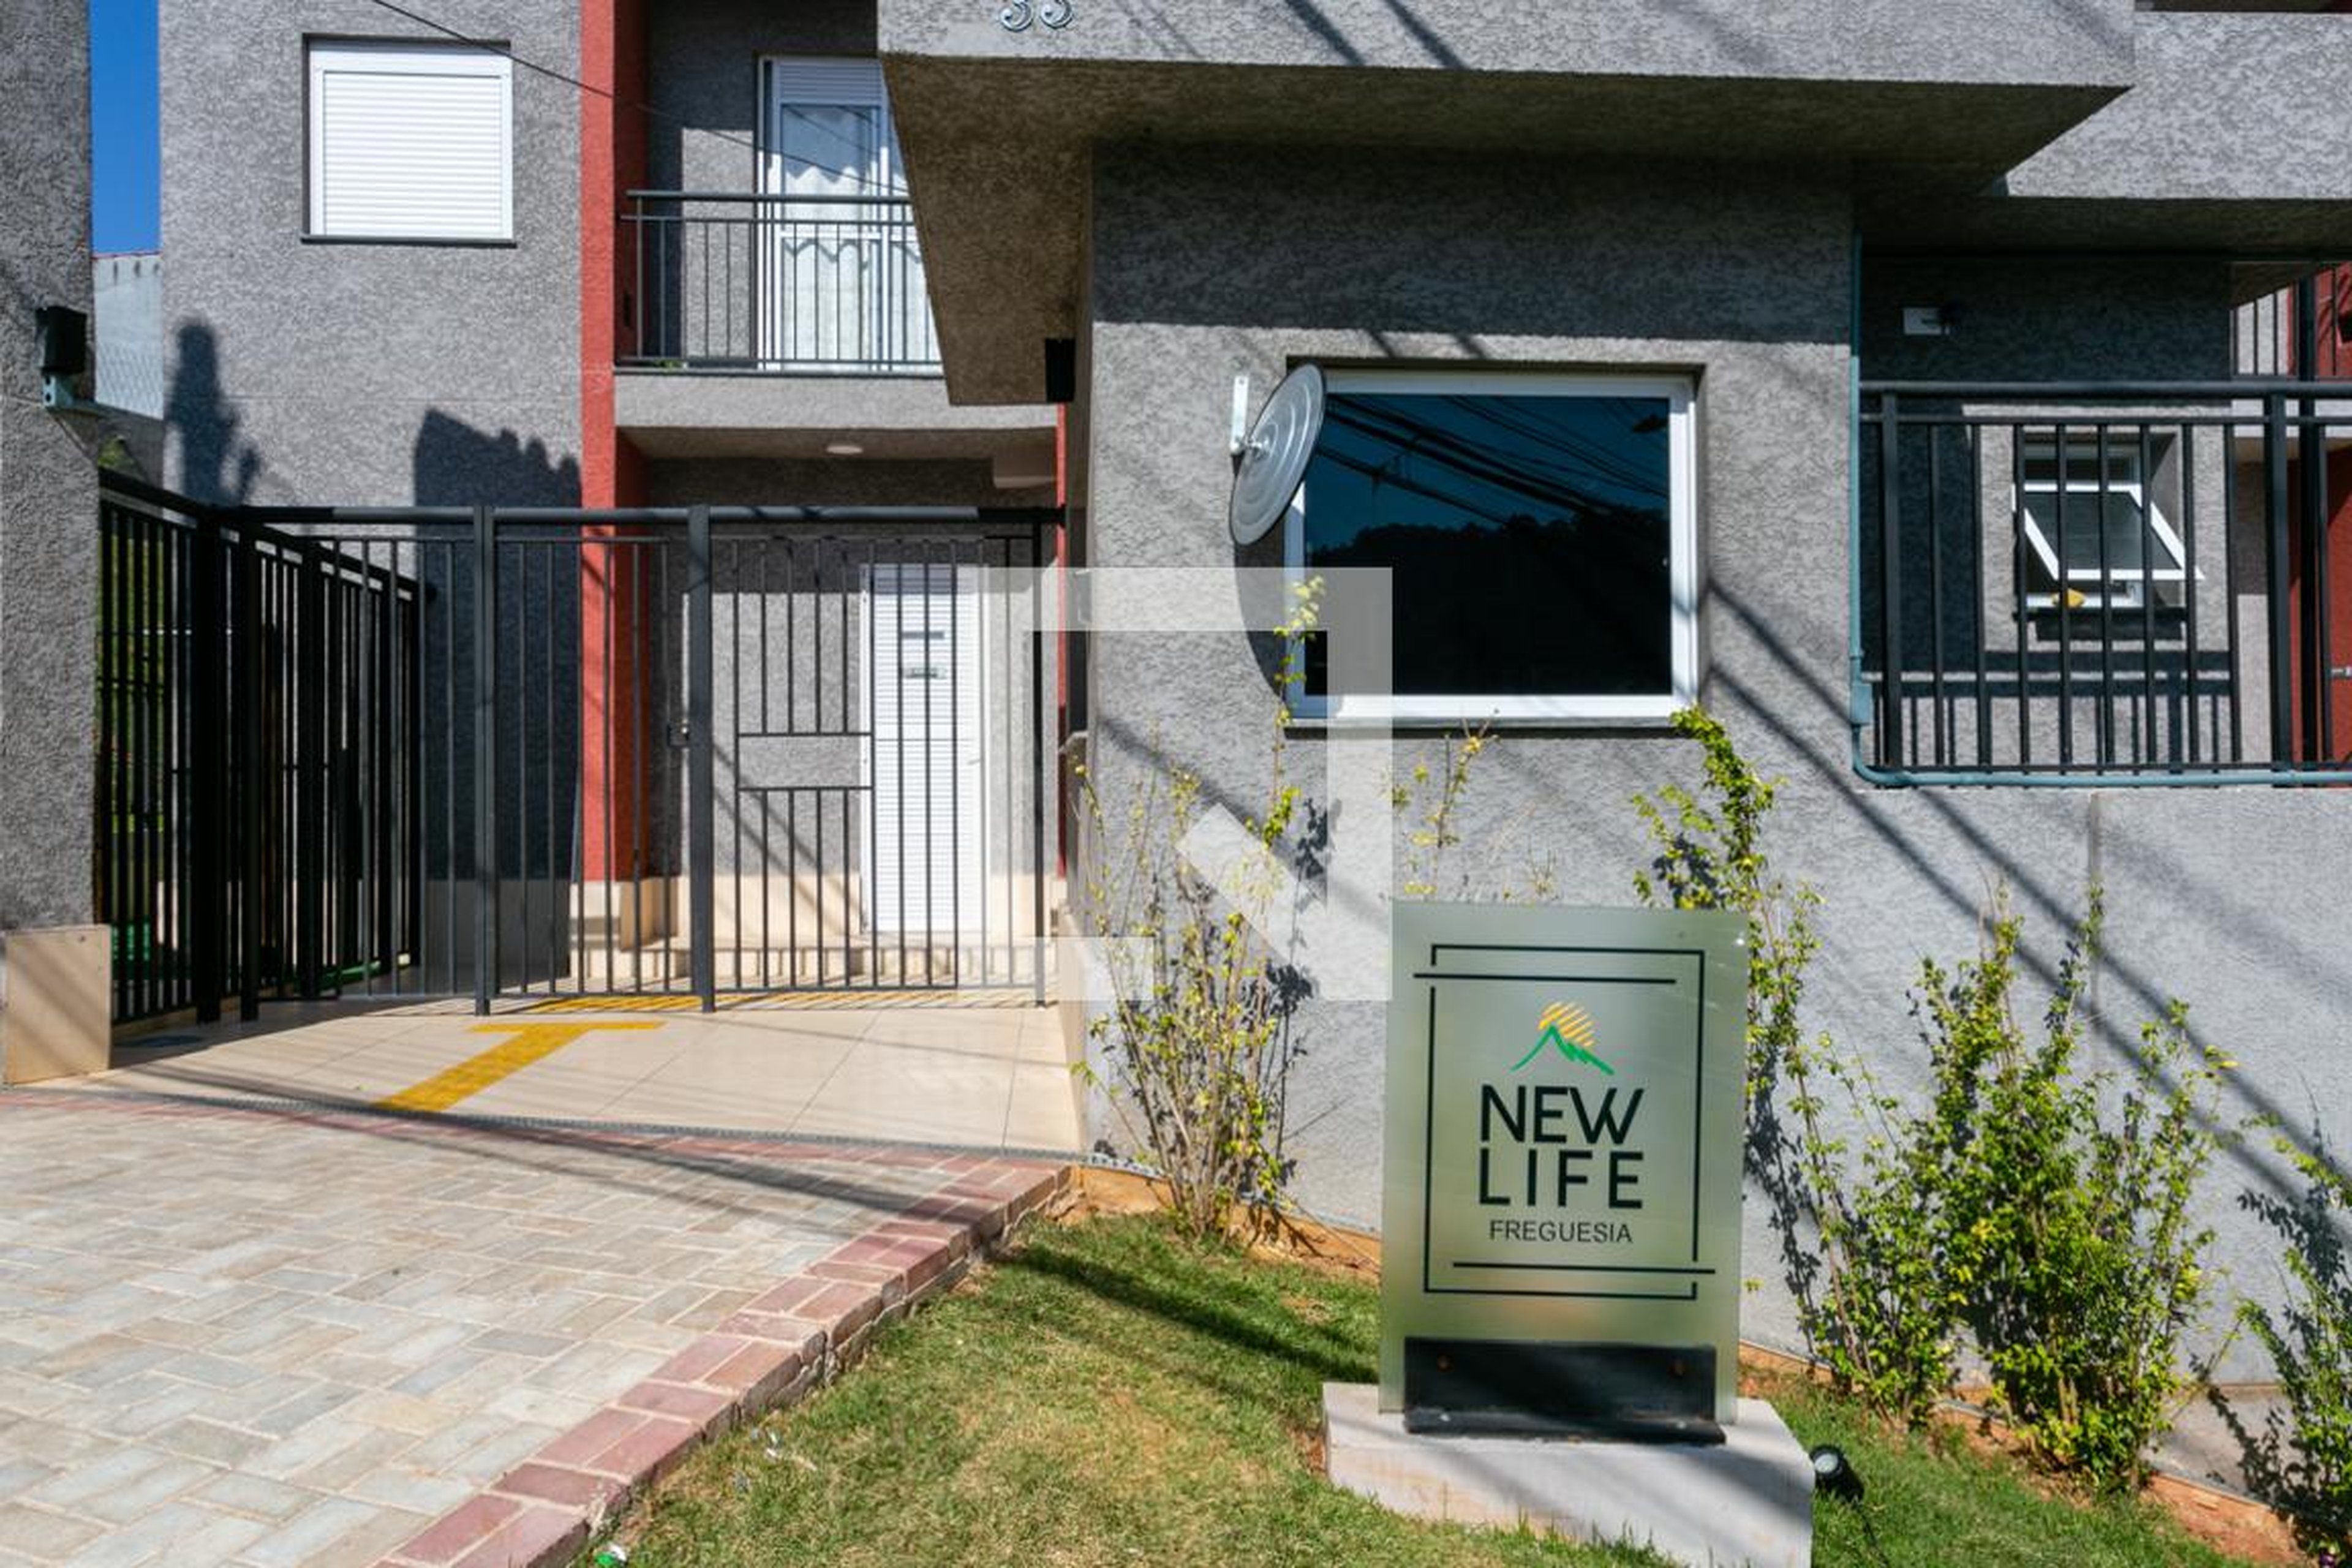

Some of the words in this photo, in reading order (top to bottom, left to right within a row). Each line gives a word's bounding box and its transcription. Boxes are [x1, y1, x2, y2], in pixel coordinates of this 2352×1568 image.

[1481, 1084, 1645, 1144] NEW
[1479, 1148, 1644, 1208] LIFE
[1490, 1219, 1632, 1243] FREGUESIA
